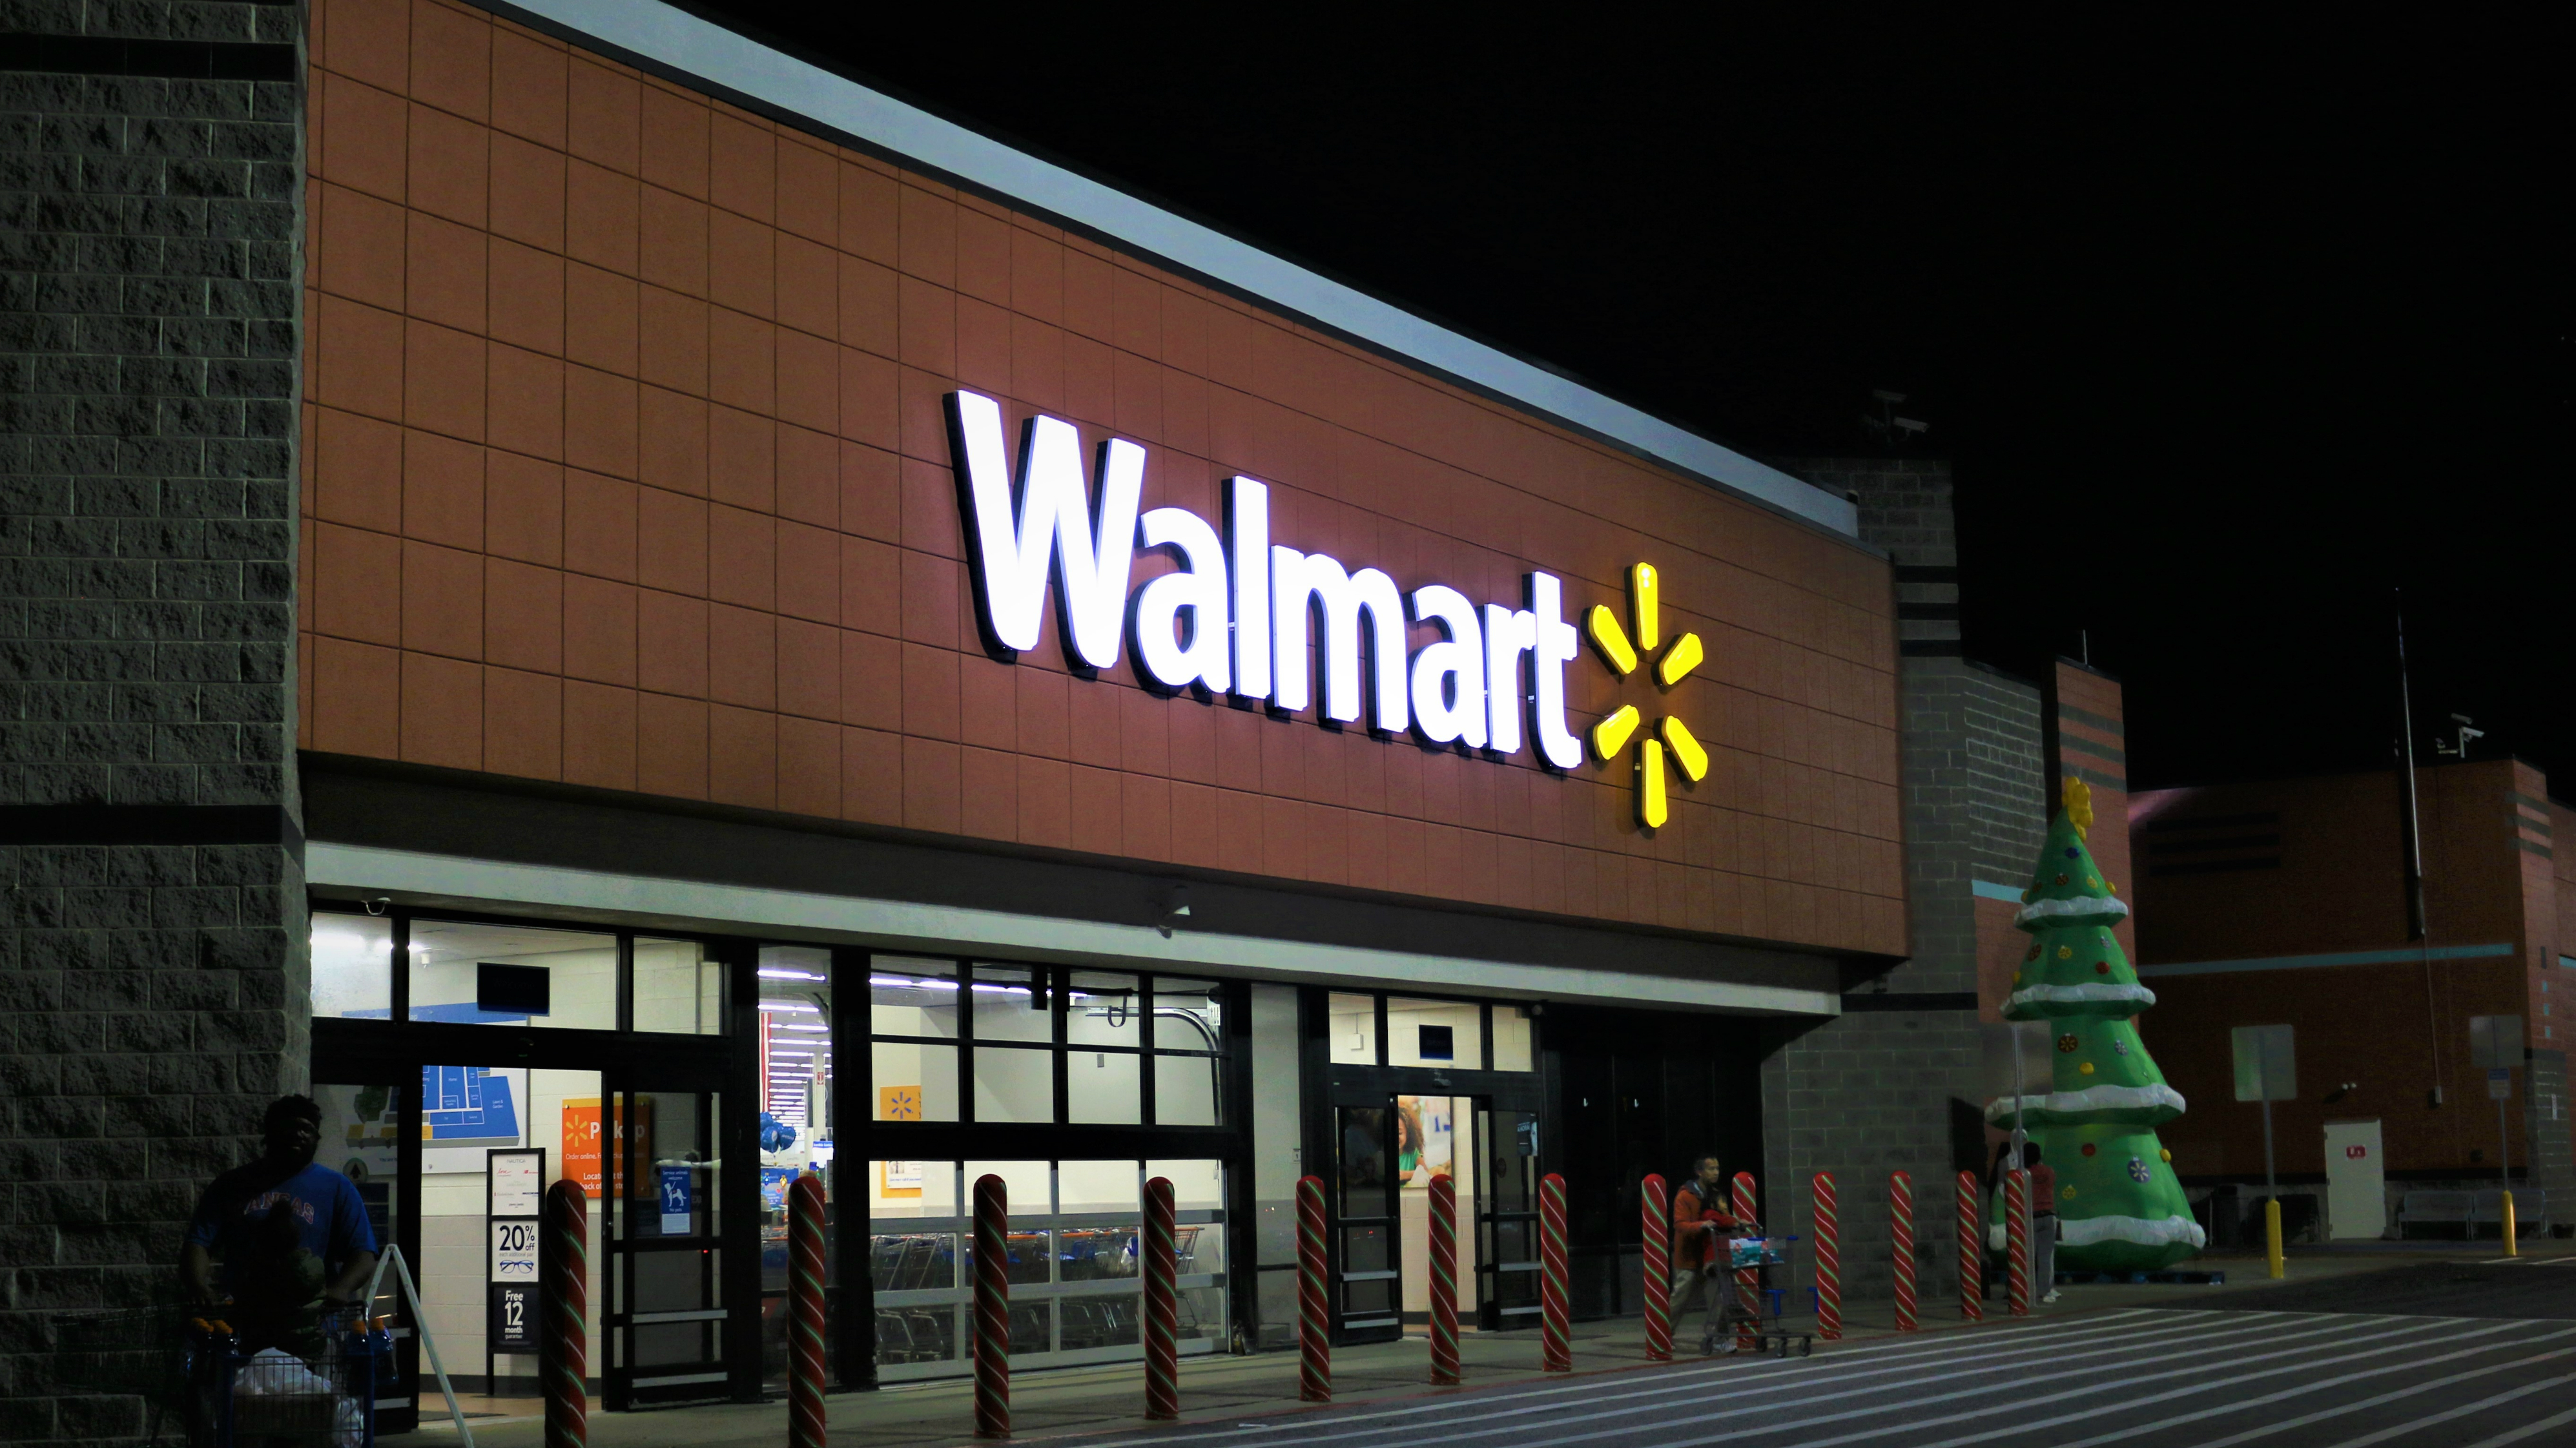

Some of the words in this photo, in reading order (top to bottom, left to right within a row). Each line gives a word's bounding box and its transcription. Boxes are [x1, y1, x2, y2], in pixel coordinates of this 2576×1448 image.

[953, 389, 1583, 770] Walmart
[590, 1120, 645, 1143] Pkp
[234, 1192, 314, 1225] ANAS
[499, 1225, 535, 1251] 20%
[525, 1242, 535, 1252] off
[505, 1290, 524, 1302] Free
[504, 1301, 524, 1327] 12
